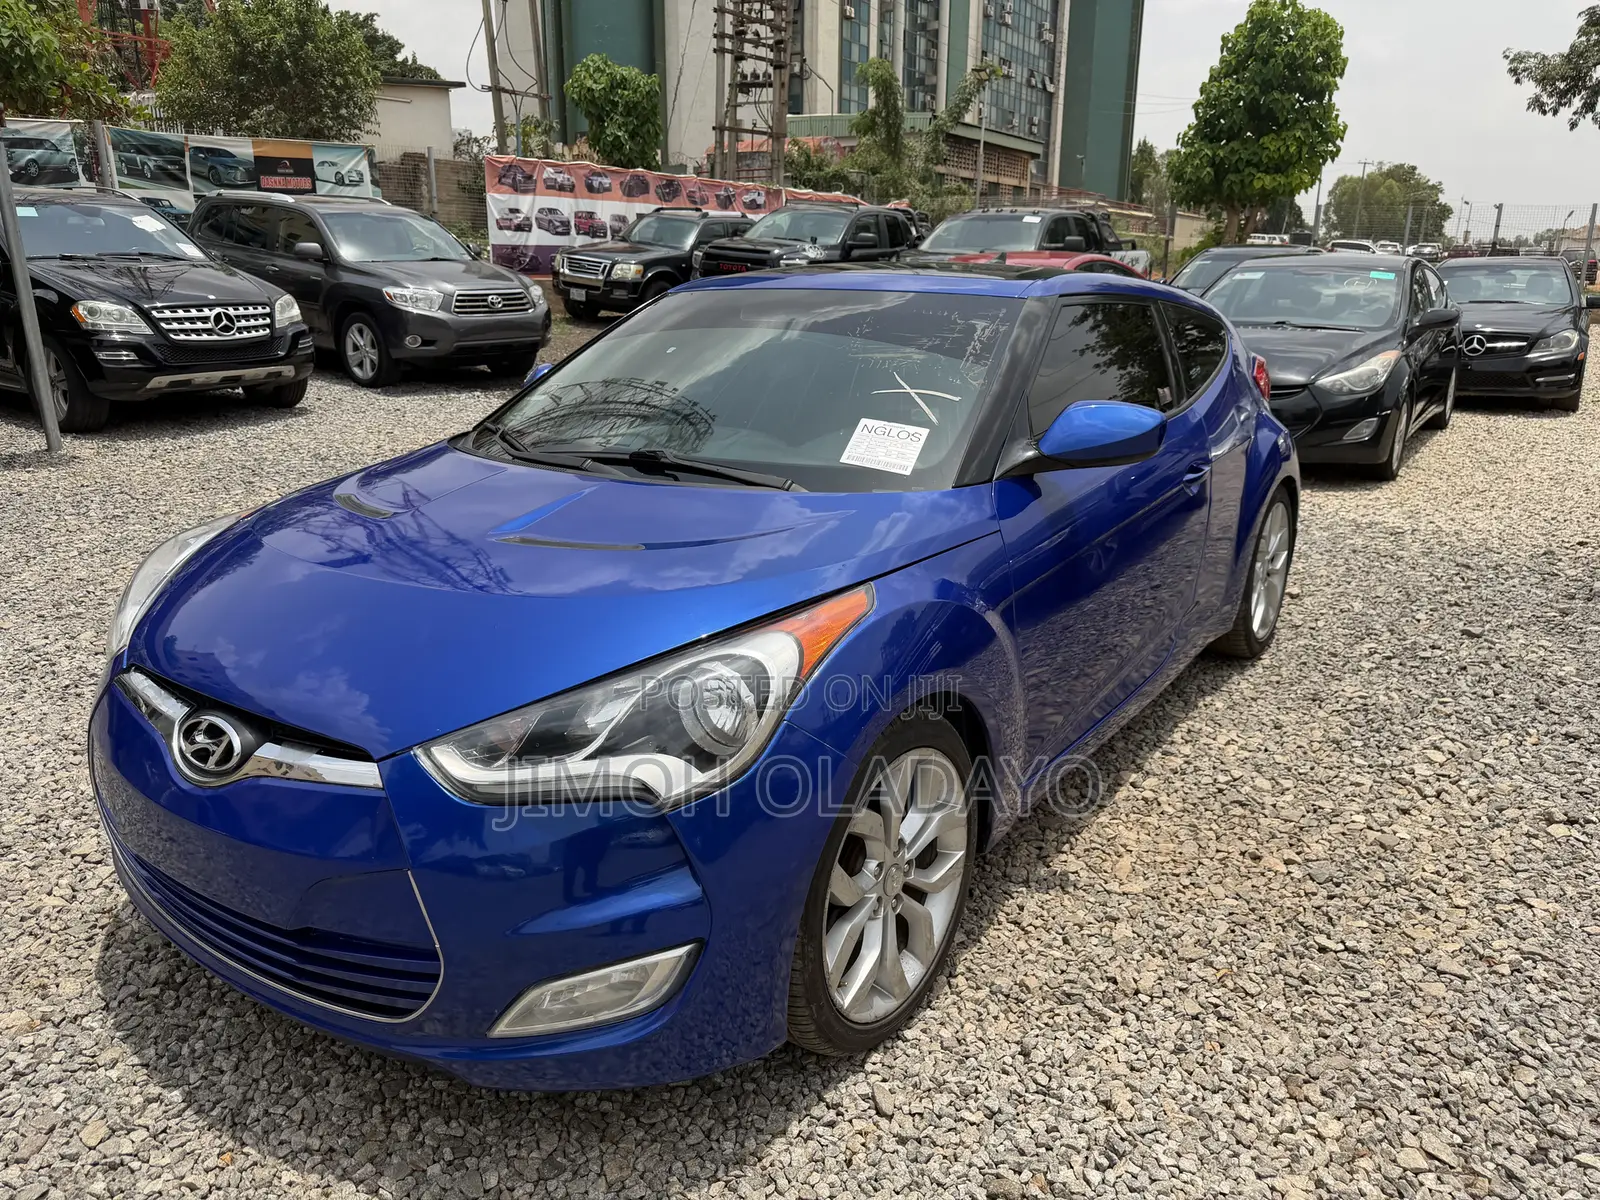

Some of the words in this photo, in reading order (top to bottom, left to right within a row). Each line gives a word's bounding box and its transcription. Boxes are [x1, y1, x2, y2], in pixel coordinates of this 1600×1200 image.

[286, 177, 312, 189] MOTORS
[719, 263, 747, 273] TOYOTA
[861, 423, 922, 442] NGLOS
